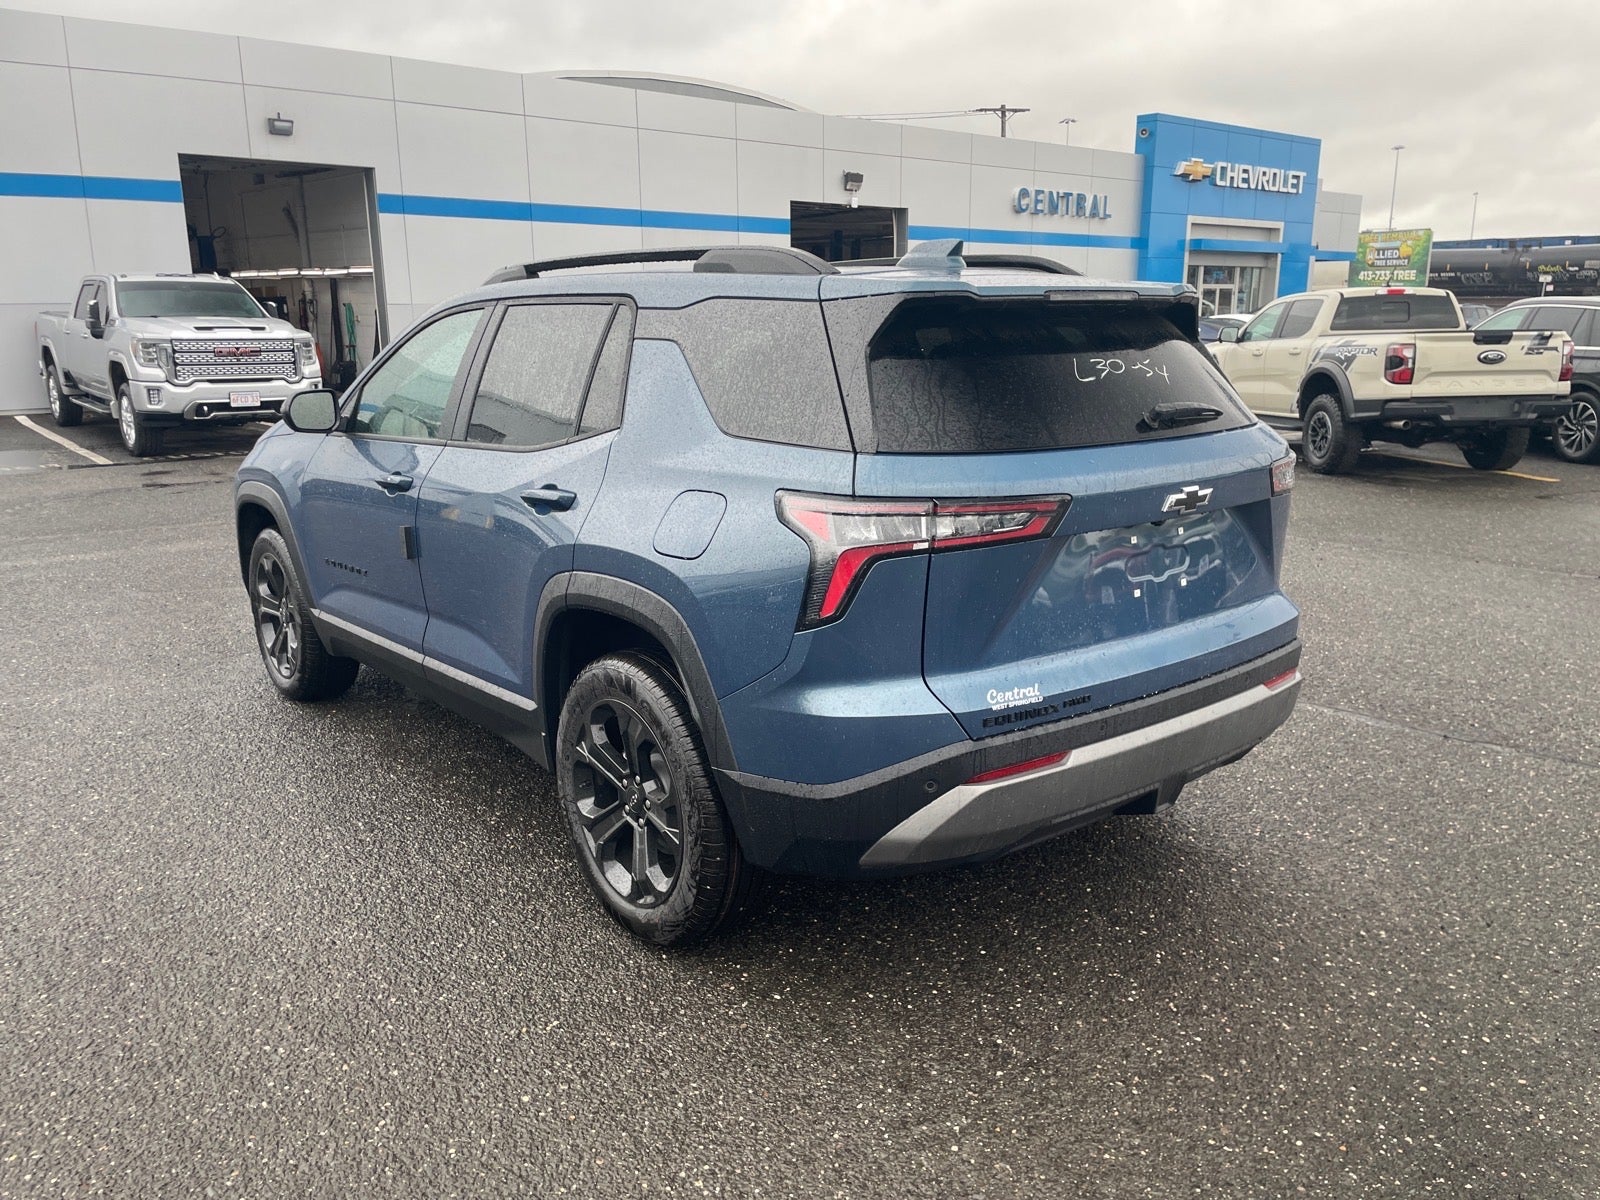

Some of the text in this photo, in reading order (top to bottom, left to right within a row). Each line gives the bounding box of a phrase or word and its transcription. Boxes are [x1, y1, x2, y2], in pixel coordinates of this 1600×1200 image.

[1213, 161, 1307, 194] CHEVROLET
[1013, 187, 1111, 219] CENTRAL
[214, 347, 261, 357] GMC
[1336, 347, 1378, 358] RAPTOR
[986, 683, 1041, 704] Central
[991, 696, 1044, 711] WEST SPRINGFIELD
[982, 703, 1060, 728] EQUINOX
